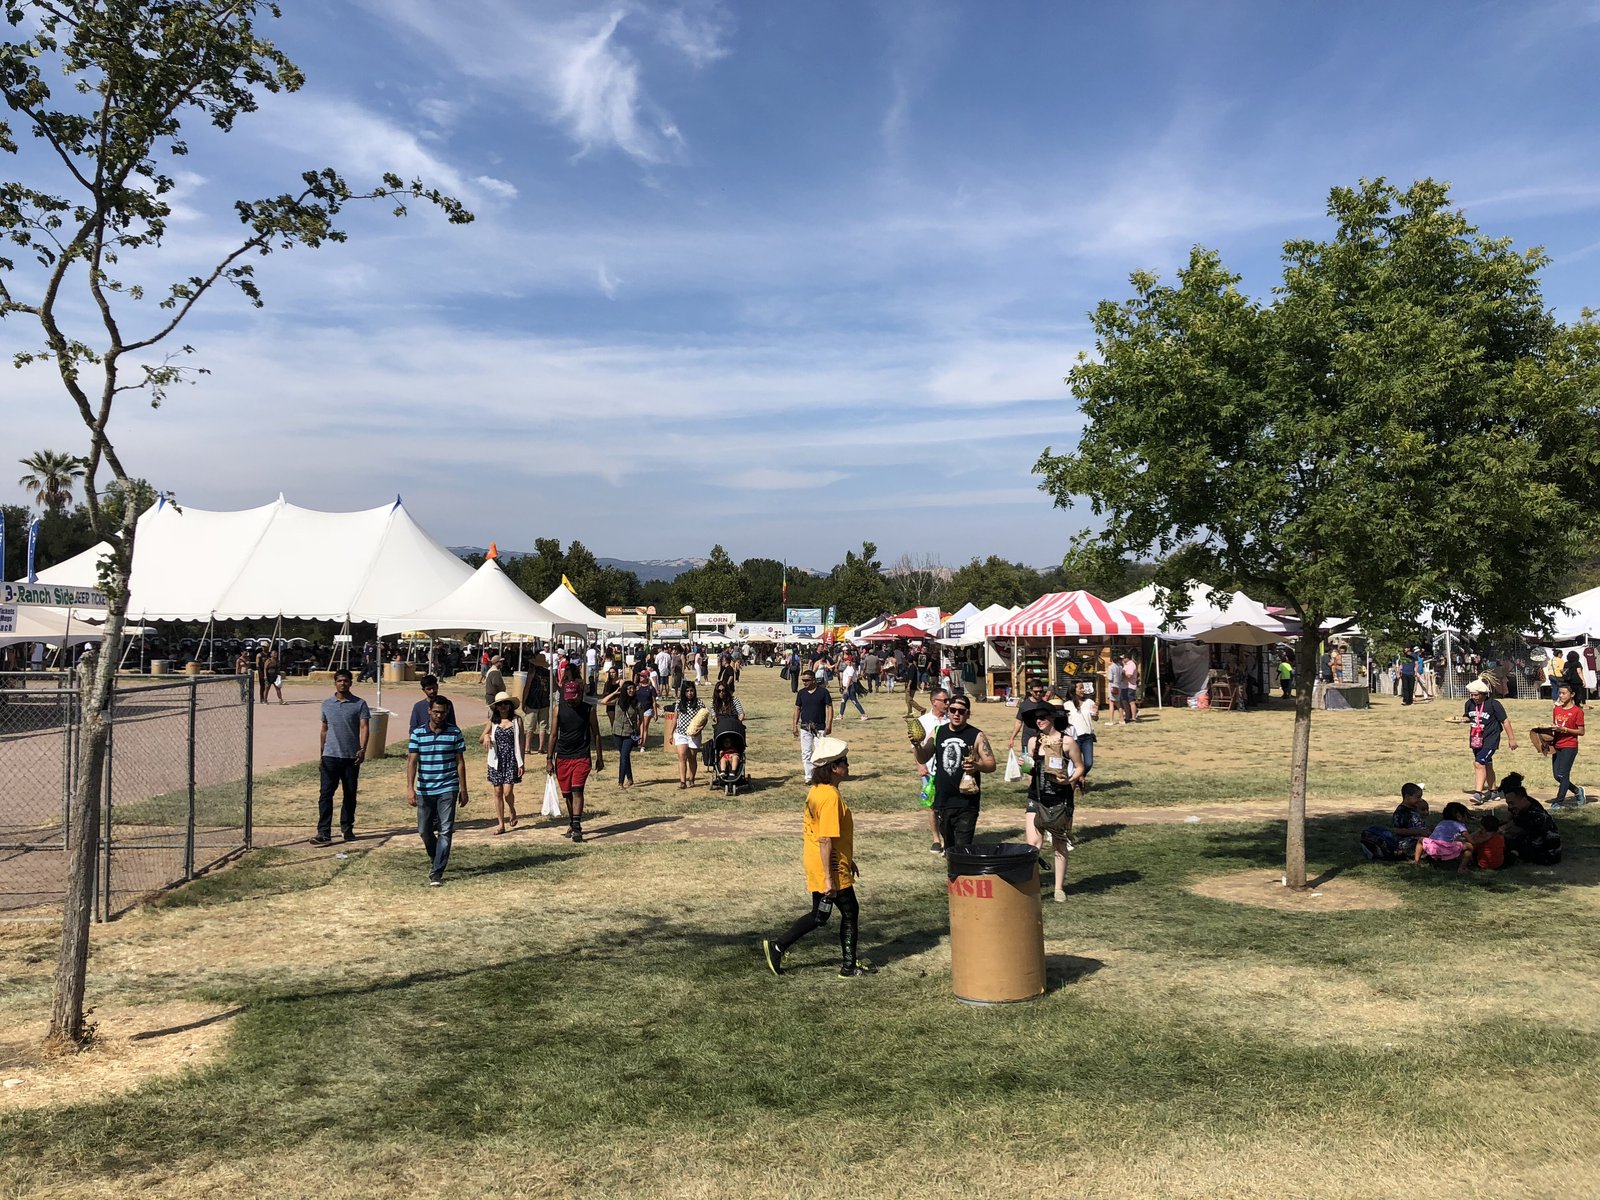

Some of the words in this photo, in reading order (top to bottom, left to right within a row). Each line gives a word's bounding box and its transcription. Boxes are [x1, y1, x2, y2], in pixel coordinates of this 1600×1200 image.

[54, 587, 74, 605] Side
[91, 592, 106, 606] TICKE
[0, 623, 13, 632] ach
